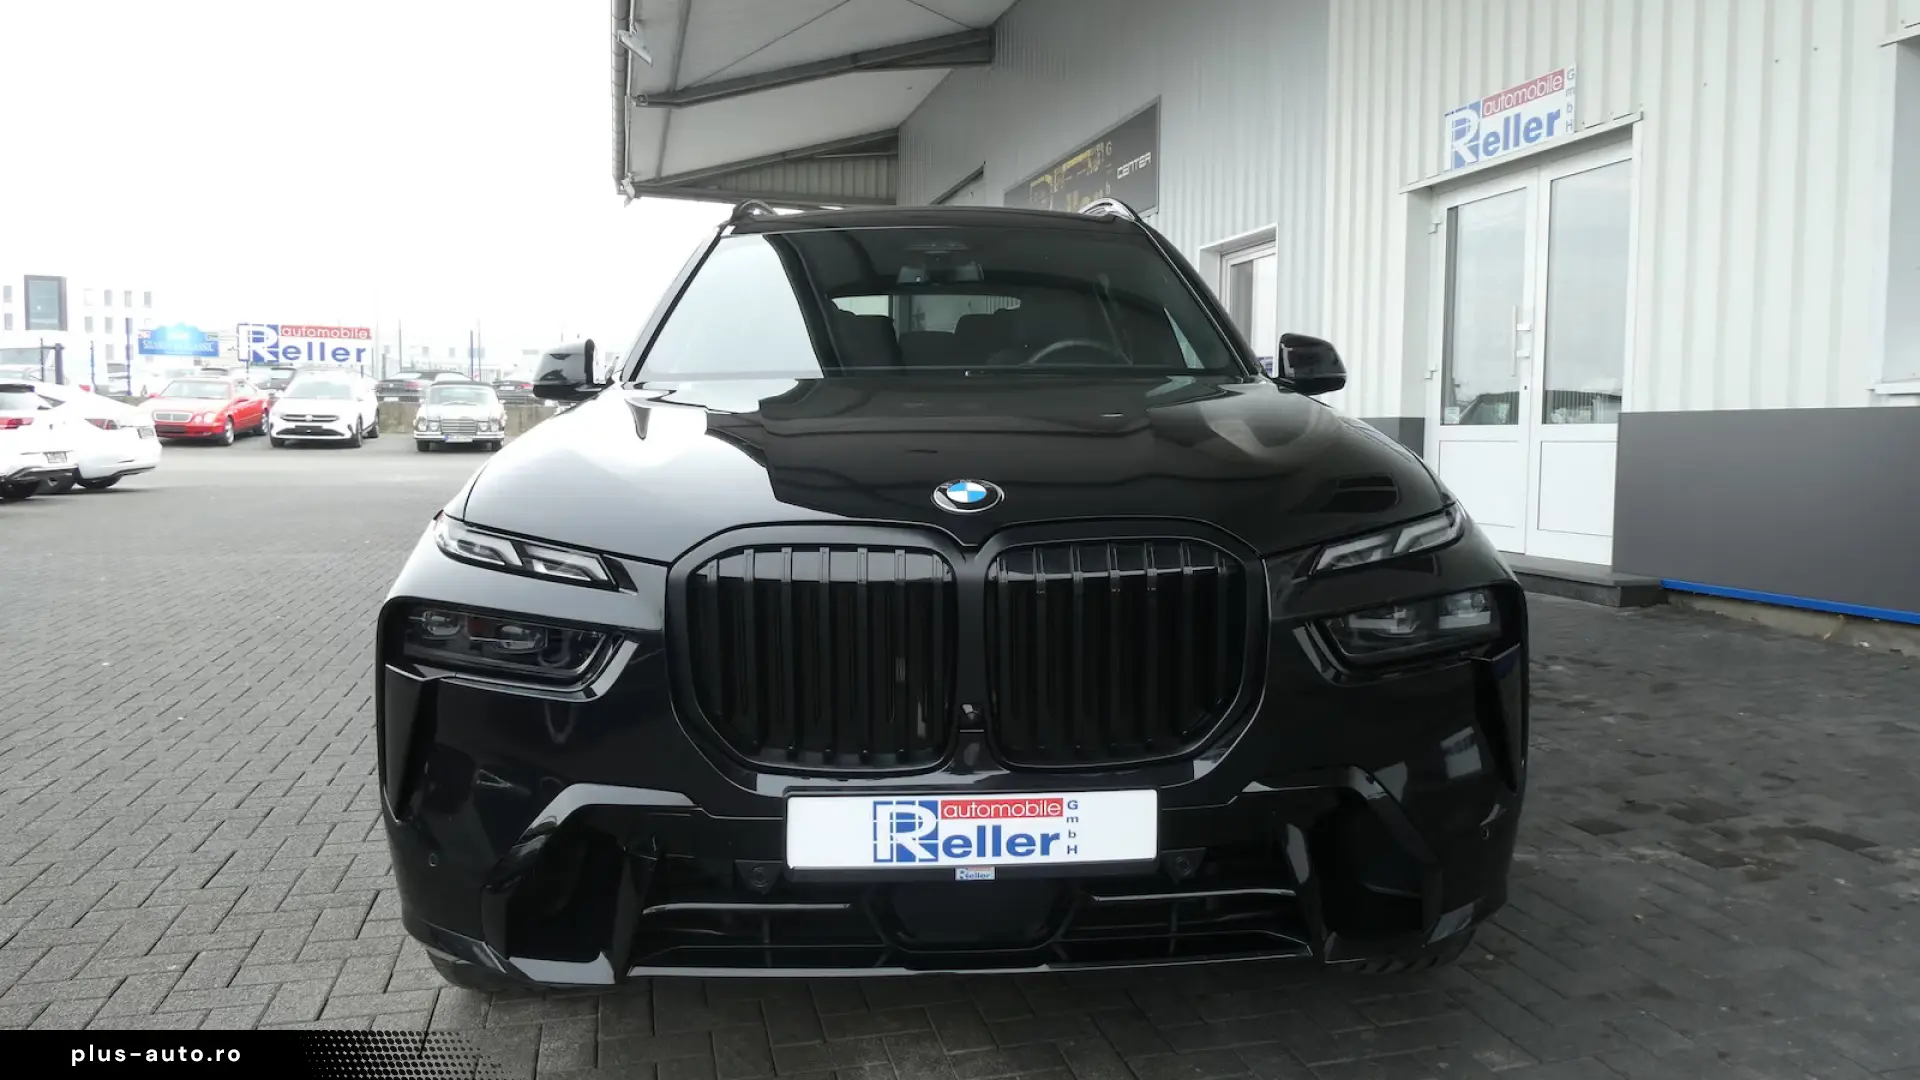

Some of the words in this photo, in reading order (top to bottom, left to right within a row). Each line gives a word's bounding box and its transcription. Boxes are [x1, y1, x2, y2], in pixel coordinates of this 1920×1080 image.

[1483, 73, 1563, 116] automobile
[1444, 102, 1561, 170] Reller
[1116, 151, 1152, 180] CENTER
[237, 324, 367, 362] Reller
[281, 326, 368, 339] automobile
[943, 799, 1061, 818] automobile
[873, 800, 1061, 863] Reller
